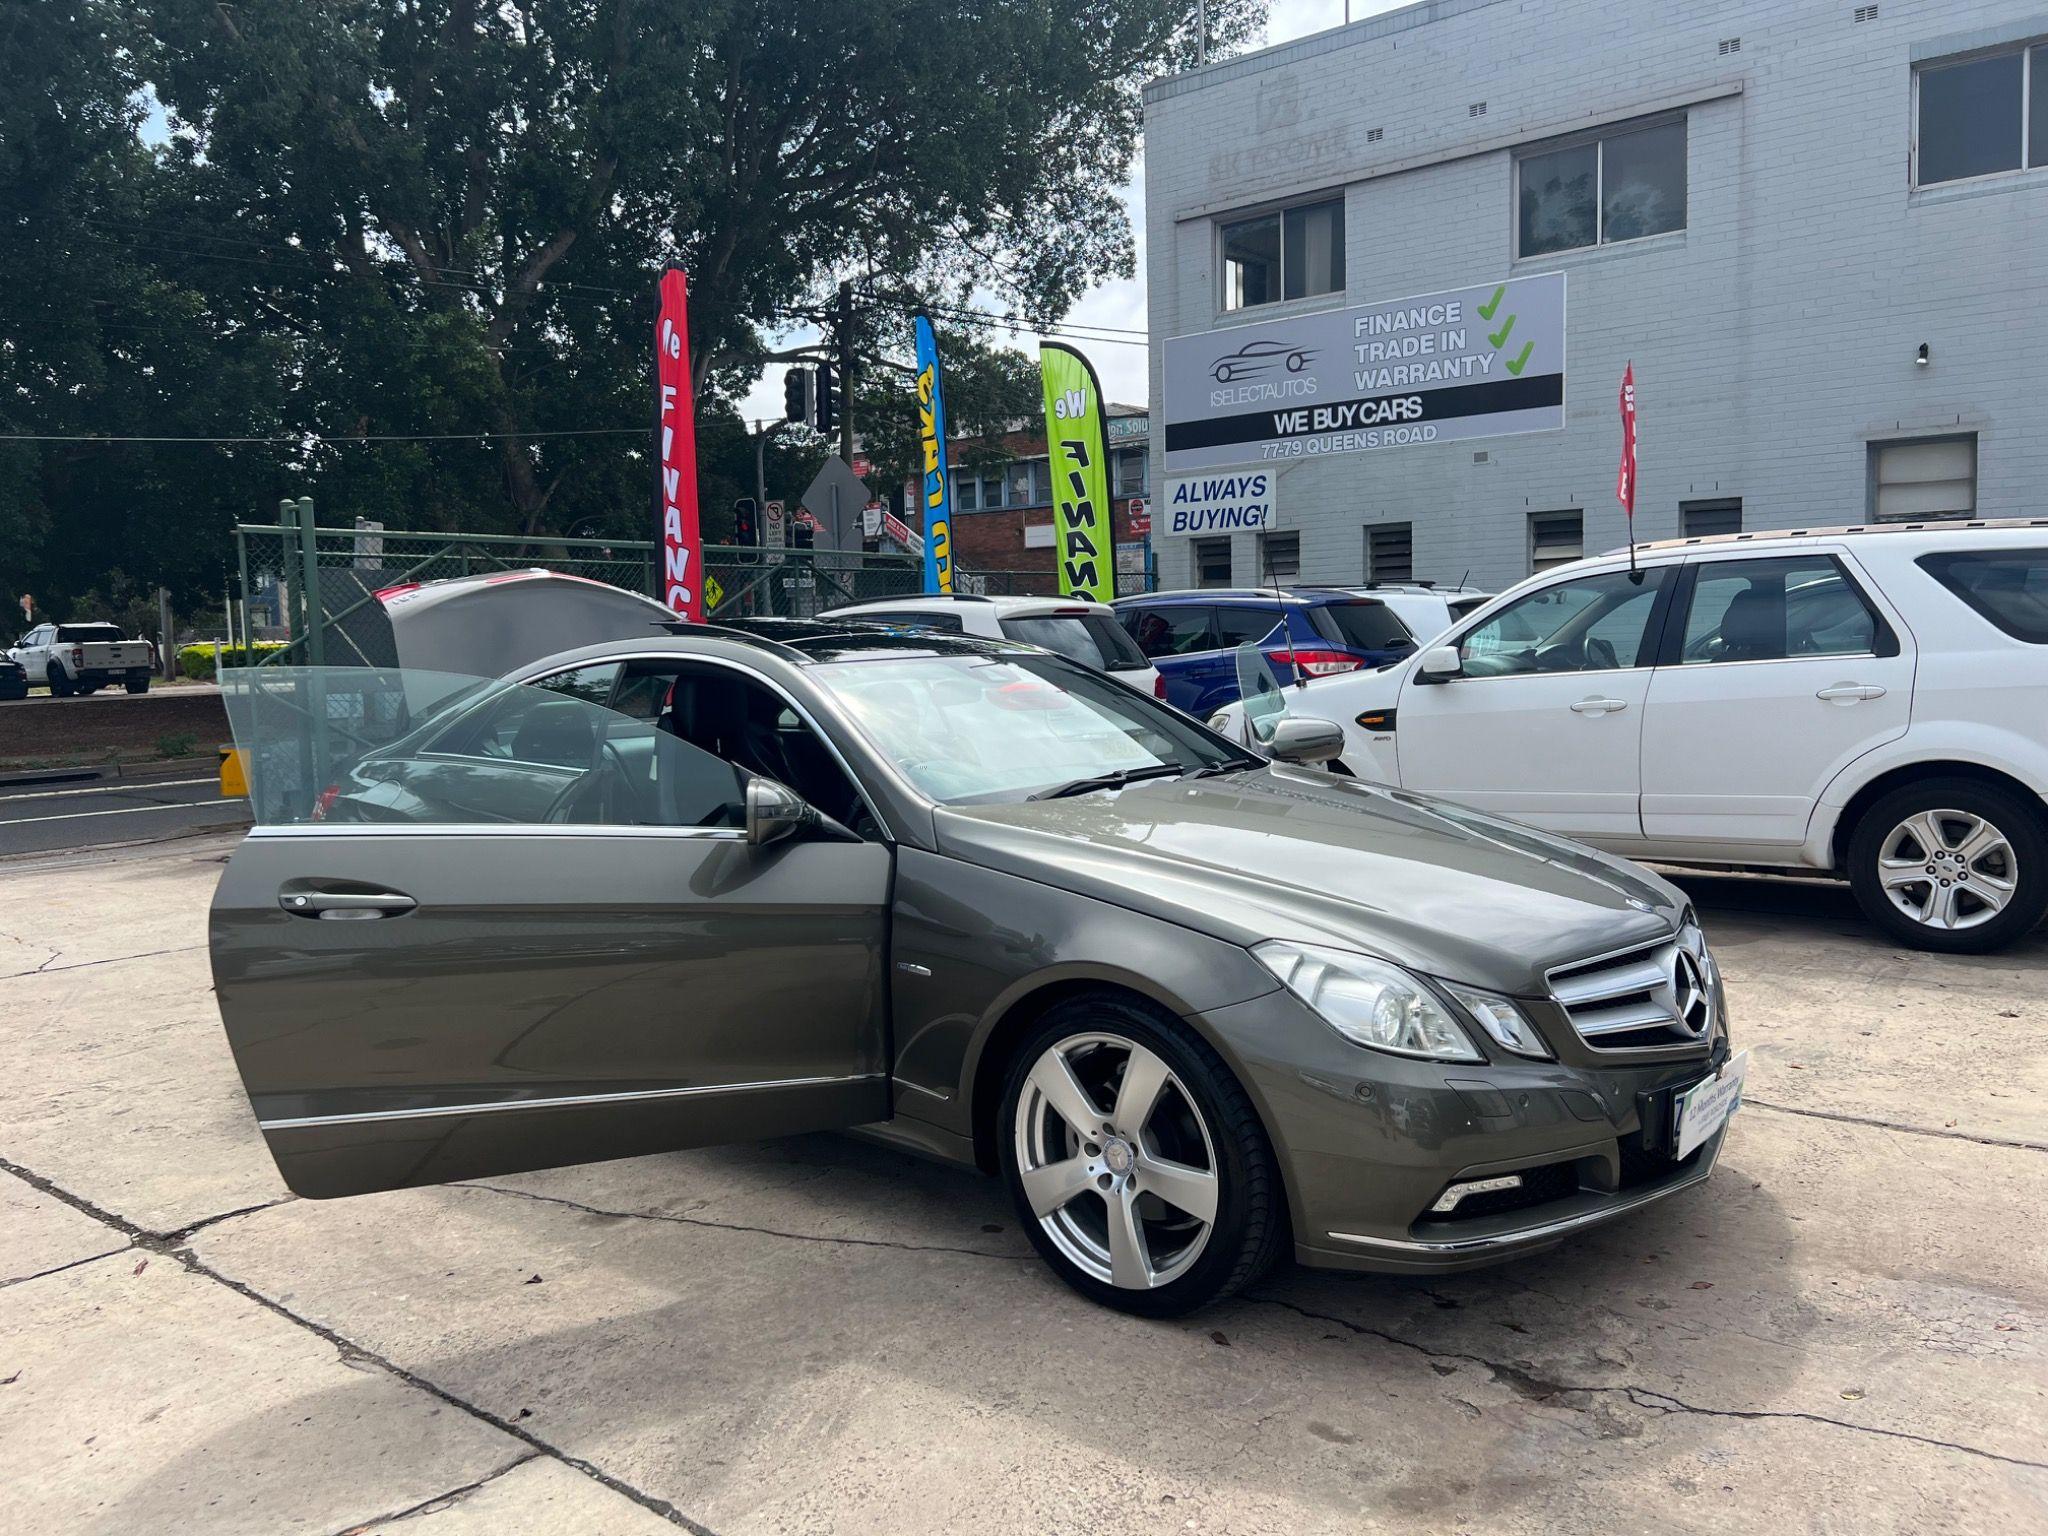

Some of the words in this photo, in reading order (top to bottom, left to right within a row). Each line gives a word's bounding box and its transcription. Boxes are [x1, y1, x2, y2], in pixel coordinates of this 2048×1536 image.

[1354, 302, 1462, 338] FINANCE
[1354, 333, 1436, 364] TRADE
[1441, 328, 1467, 352] IN
[1354, 352, 1496, 391] WARRANTY
[1210, 377, 1318, 408] ISELECTAUTOS
[1127, 418, 1150, 434] Solu
[1273, 410, 1309, 435] WE
[1313, 403, 1359, 430] BUY
[1359, 395, 1423, 424] CARS
[1261, 440, 1303, 459] 77-79
[1307, 431, 1379, 454] QUEENS
[1383, 425, 1438, 446] ROAD
[1172, 475, 1267, 504] ALWAYS
[769, 522, 780, 530] NO
[1172, 504, 1269, 532] BUYING!
